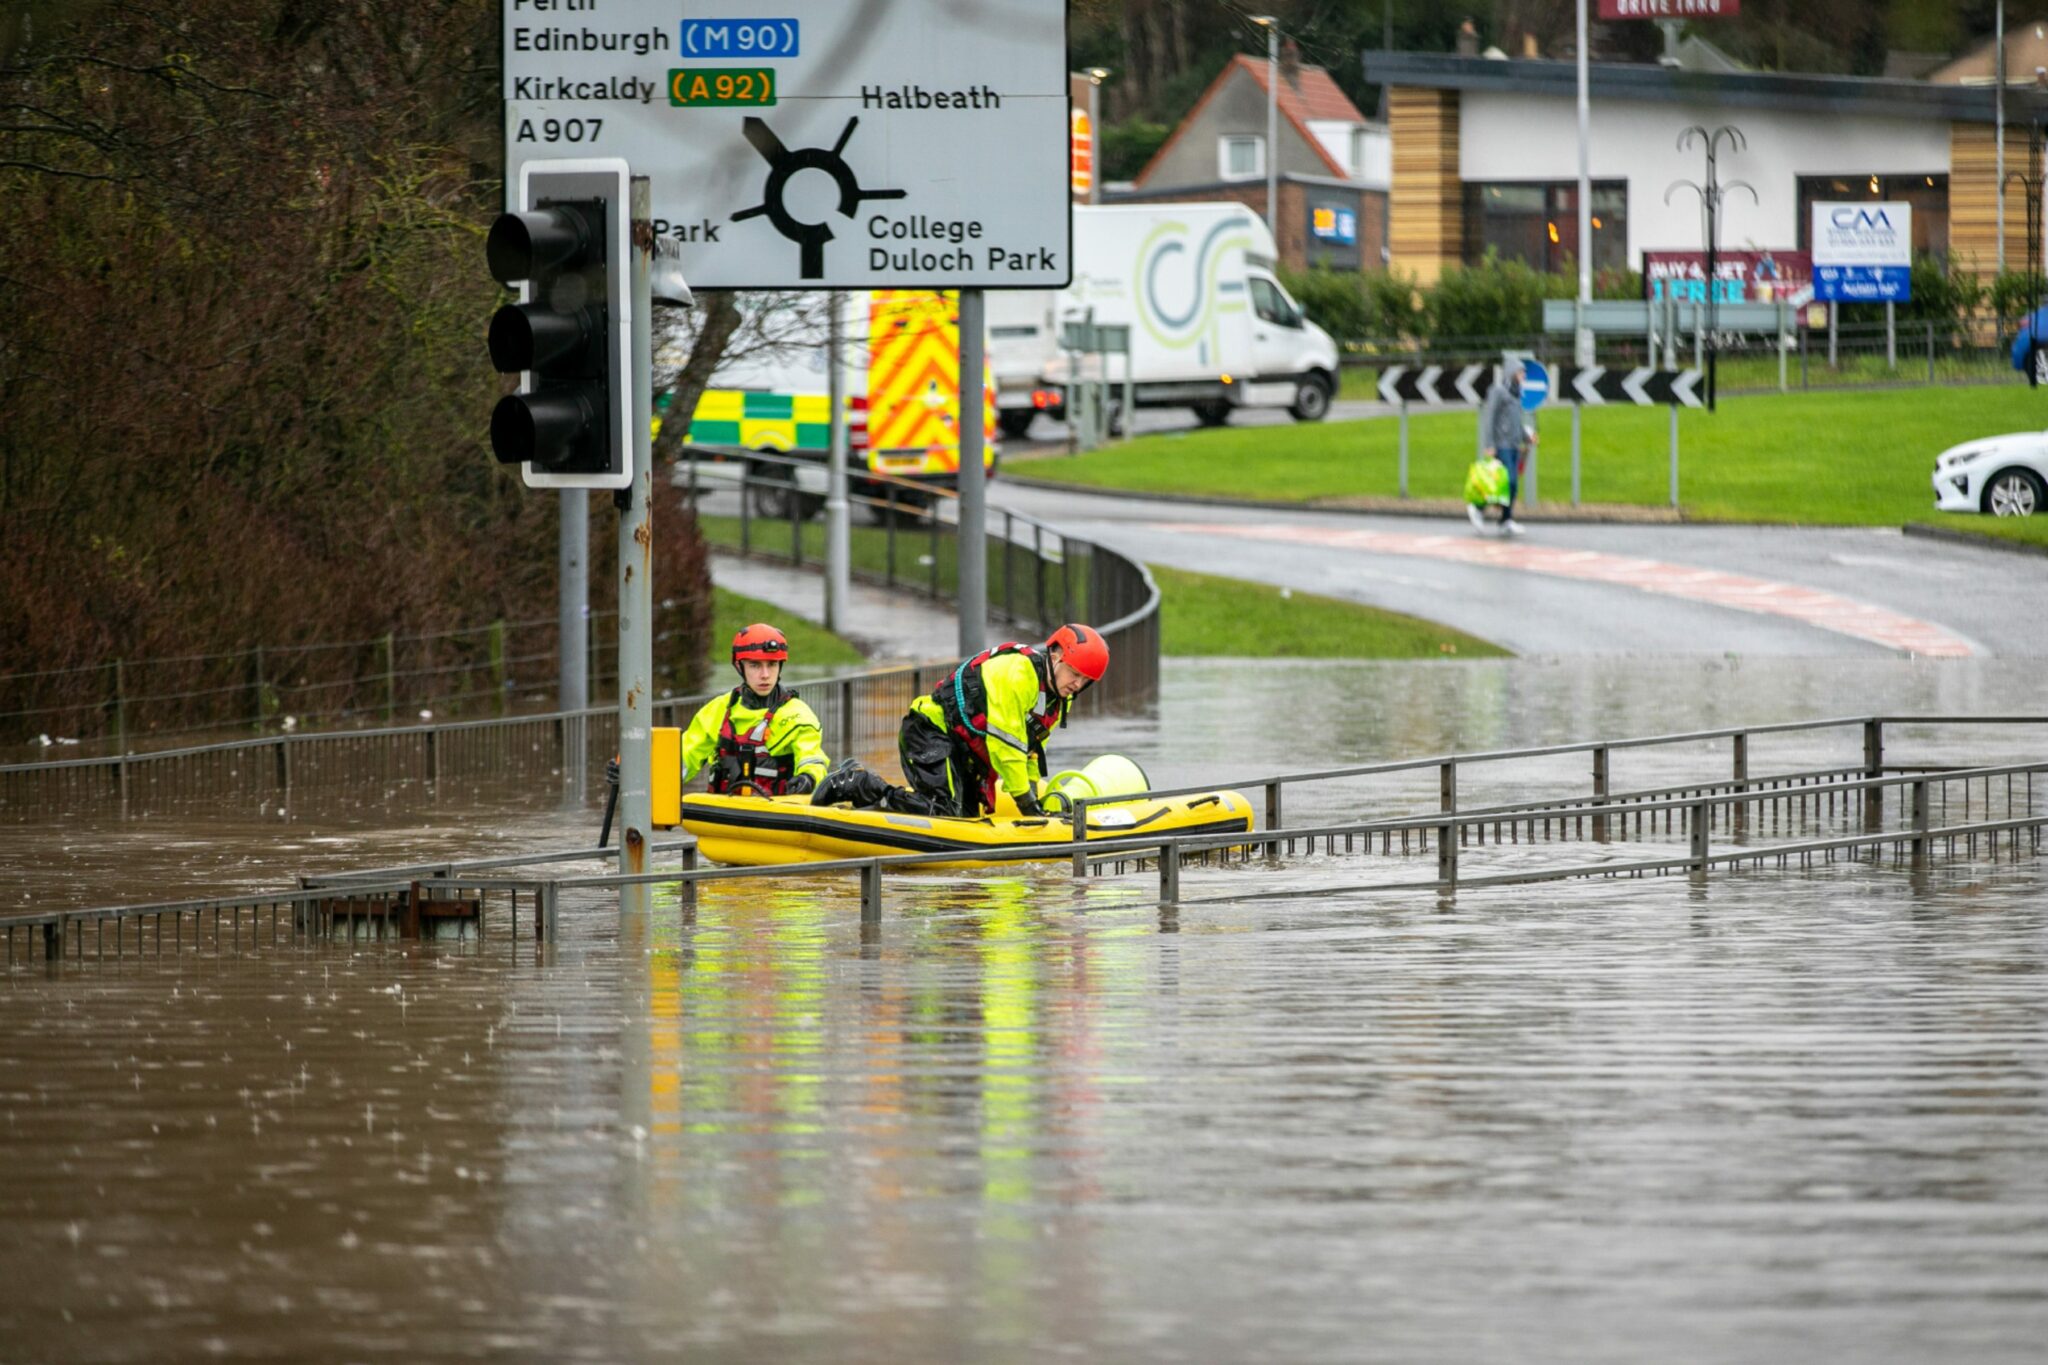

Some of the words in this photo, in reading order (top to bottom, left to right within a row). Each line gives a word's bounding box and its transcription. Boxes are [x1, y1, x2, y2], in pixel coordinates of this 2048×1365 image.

[514, 27, 669, 55] Edinburgh
[514, 76, 656, 104] Kirkcaldy
[861, 84, 1000, 109] Halbeath
[653, 218, 721, 242] Park
[868, 214, 983, 243] College
[869, 247, 974, 271] Duloch
[987, 246, 1056, 271] Park
